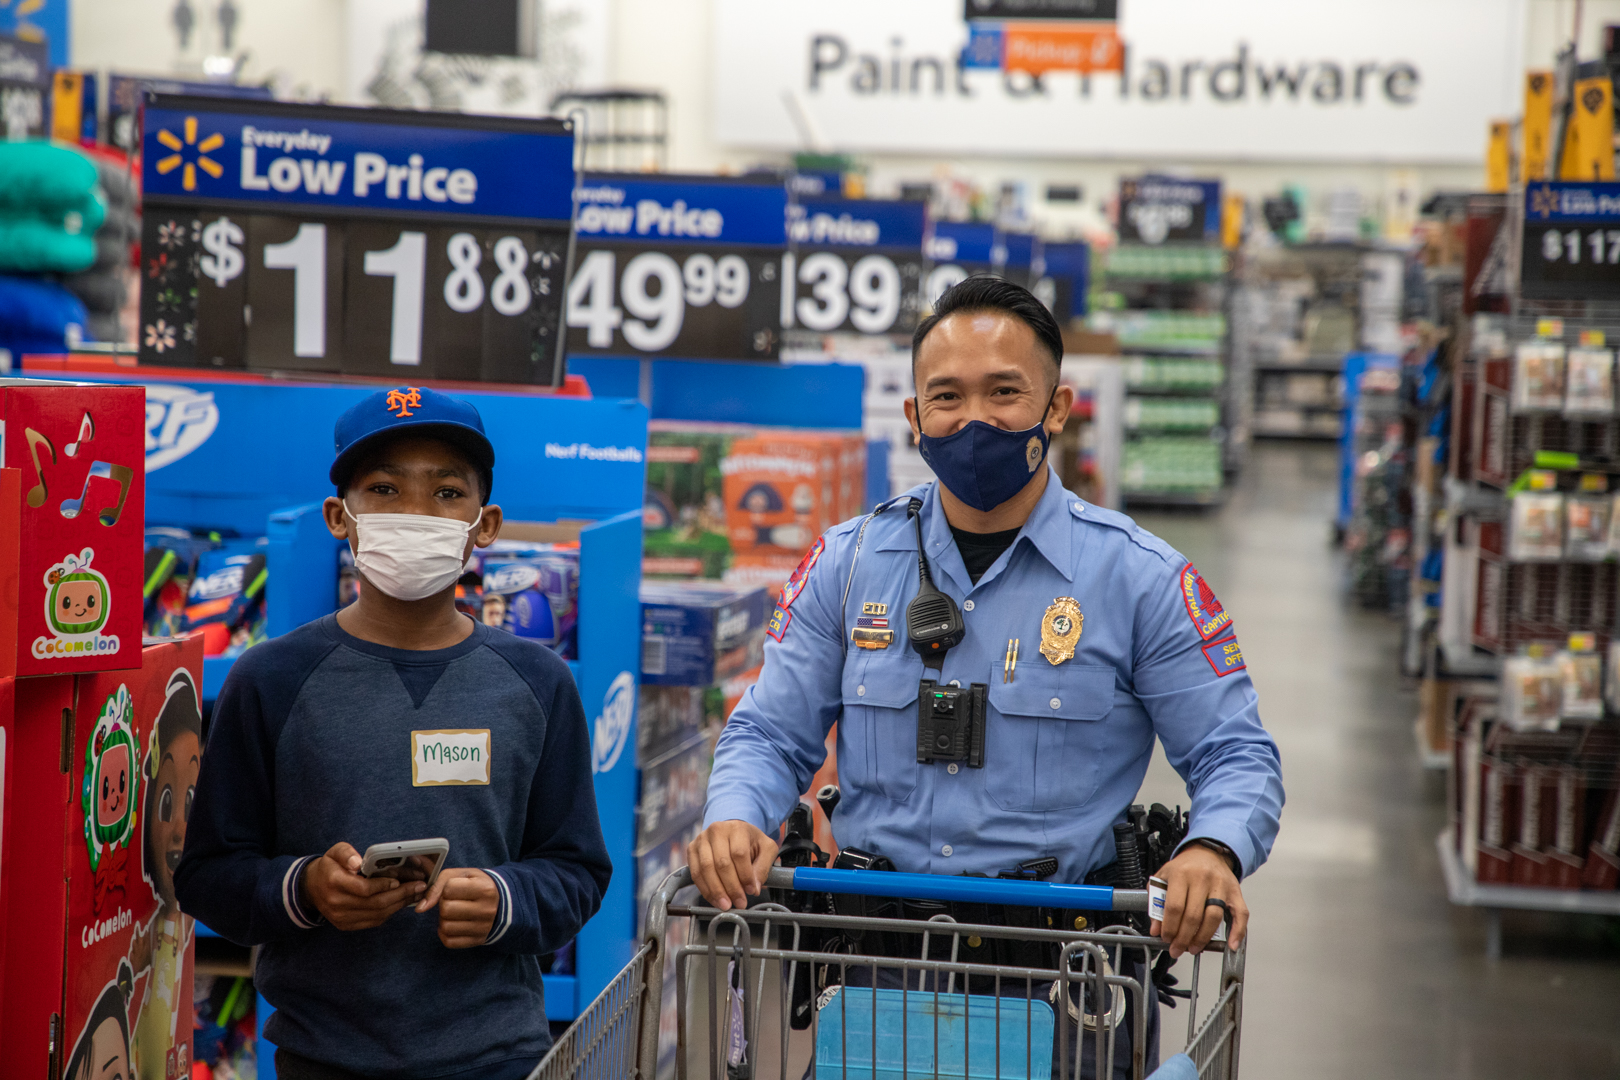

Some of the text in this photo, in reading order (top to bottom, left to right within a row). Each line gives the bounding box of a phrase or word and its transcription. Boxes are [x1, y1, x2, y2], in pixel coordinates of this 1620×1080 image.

[810, 34, 977, 97] Paint
[242, 126, 331, 155] Everyday
[241, 146, 478, 204] Low Price
[575, 199, 724, 238] ow Price
[545, 442, 578, 459] Nerf
[579, 443, 643, 463] Footballs
[1184, 572, 1202, 619] RALEIGH
[423, 741, 481, 765] Mason
